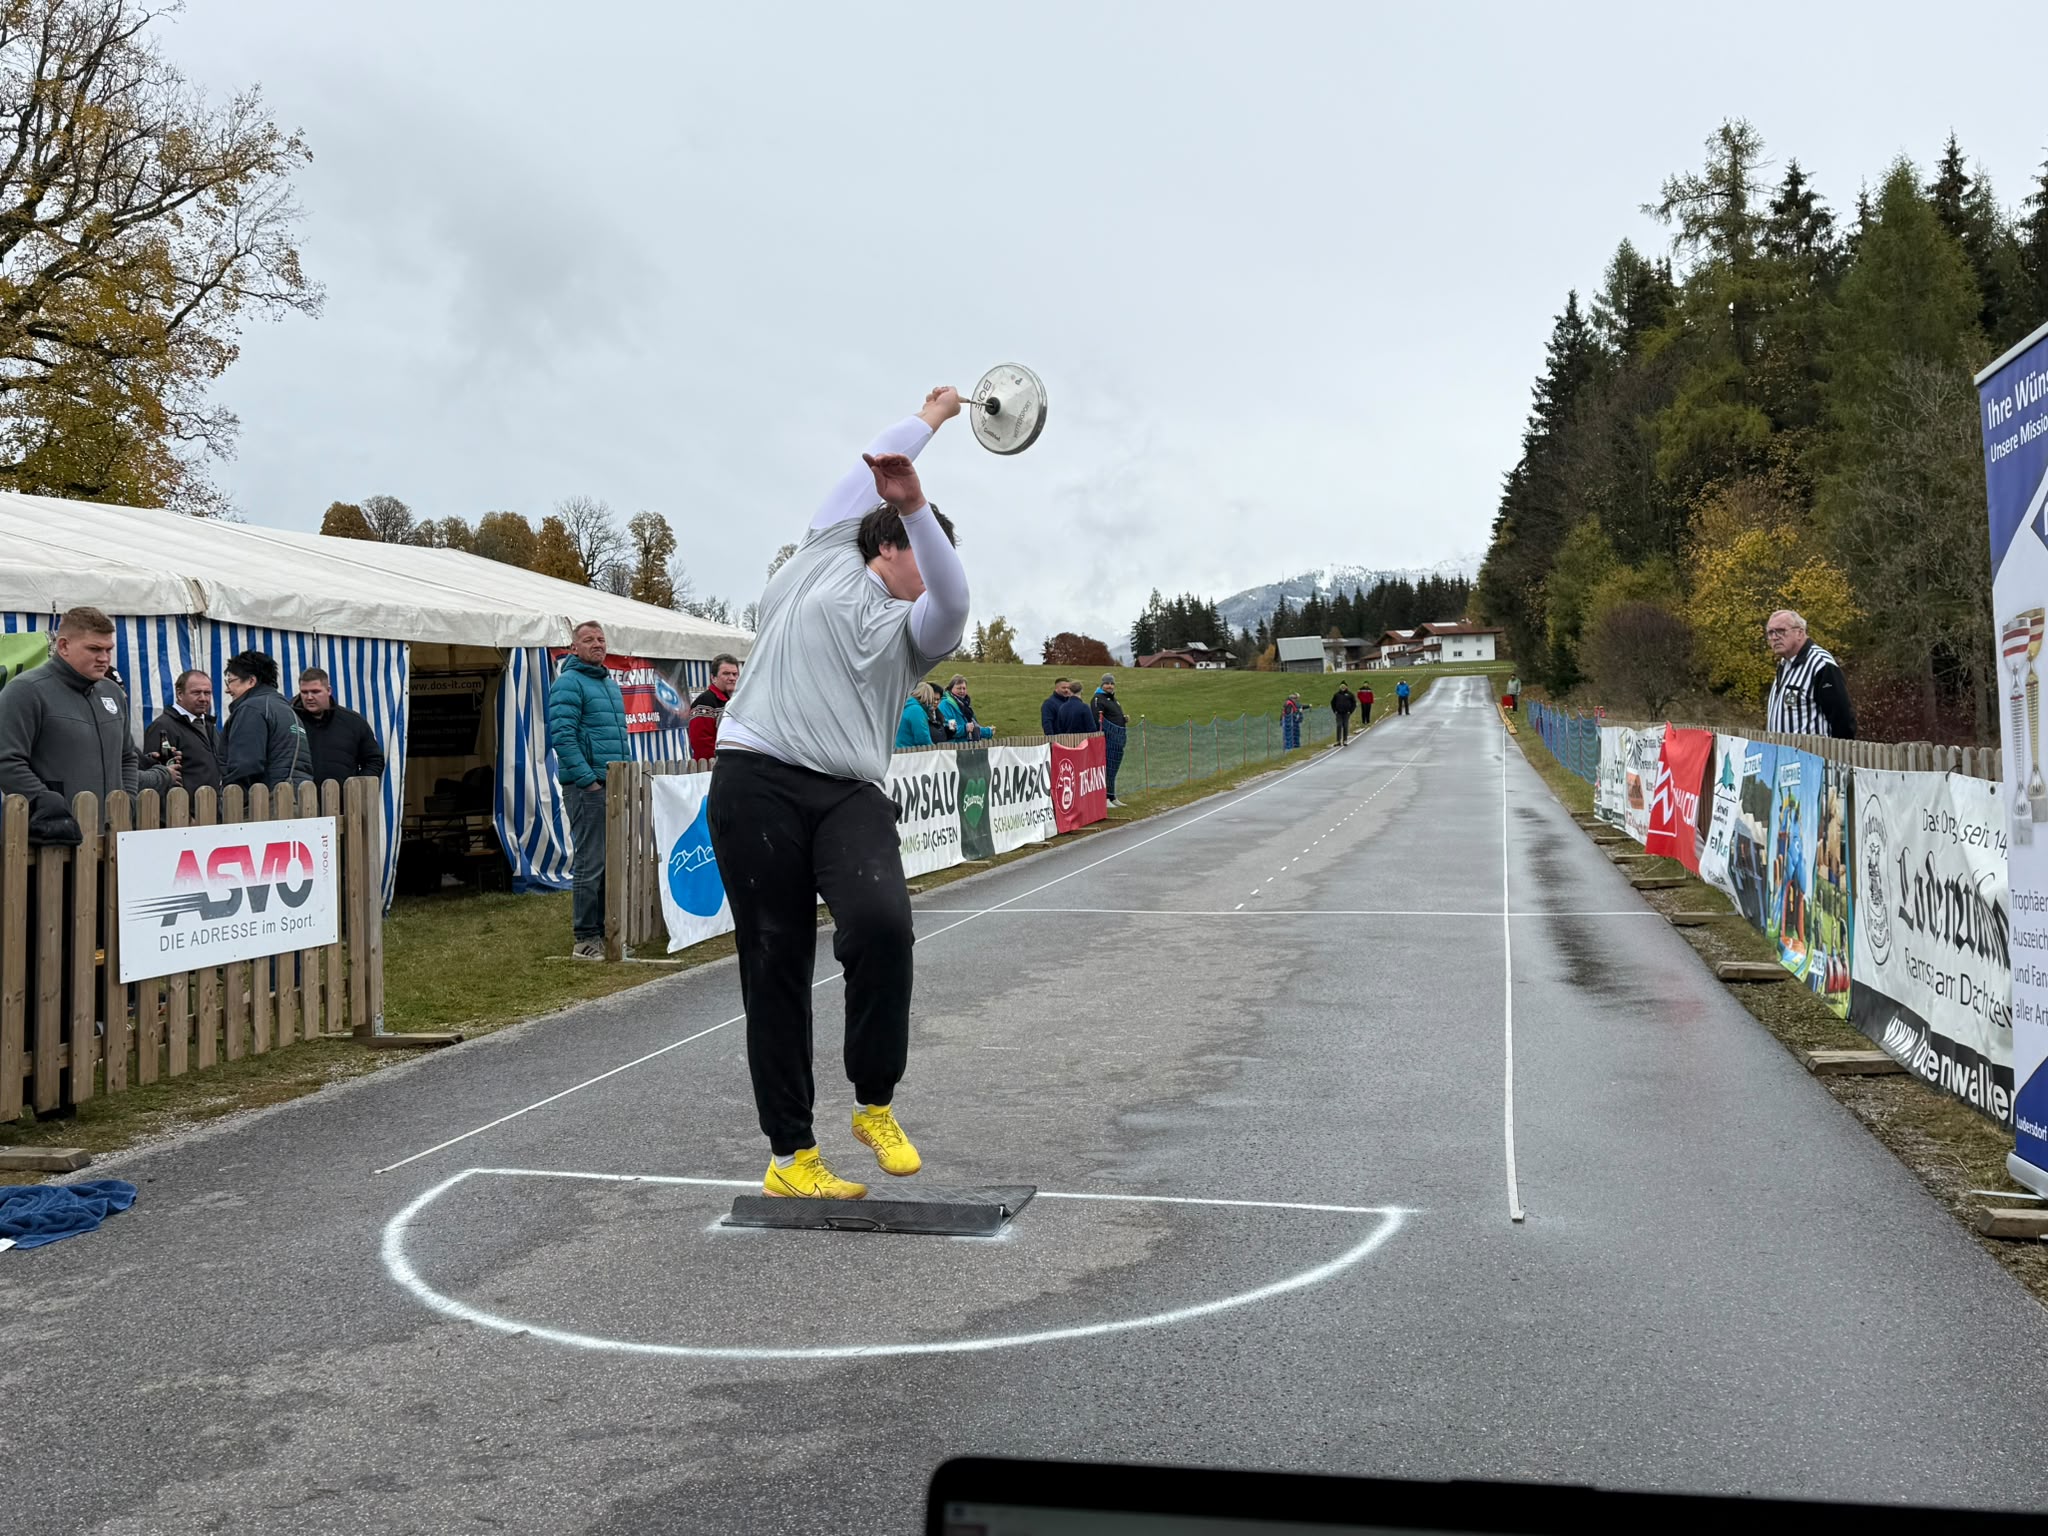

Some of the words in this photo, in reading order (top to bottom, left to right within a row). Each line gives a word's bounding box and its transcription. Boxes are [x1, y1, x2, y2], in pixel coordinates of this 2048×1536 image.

[1987, 396, 2013, 430] Ihre
[1990, 433, 2019, 463] Unsere
[991, 760, 1051, 807] RAMSAU
[1995, 829, 2008, 860] 14
[160, 932, 185, 951] DIE
[190, 921, 257, 947] ADRESSE
[262, 919, 277, 935] im
[280, 914, 316, 934] Sport.
[2014, 963, 2030, 984] und
[2016, 998, 2033, 1022] aller
[2016, 1113, 2047, 1142] Ludersdorf
